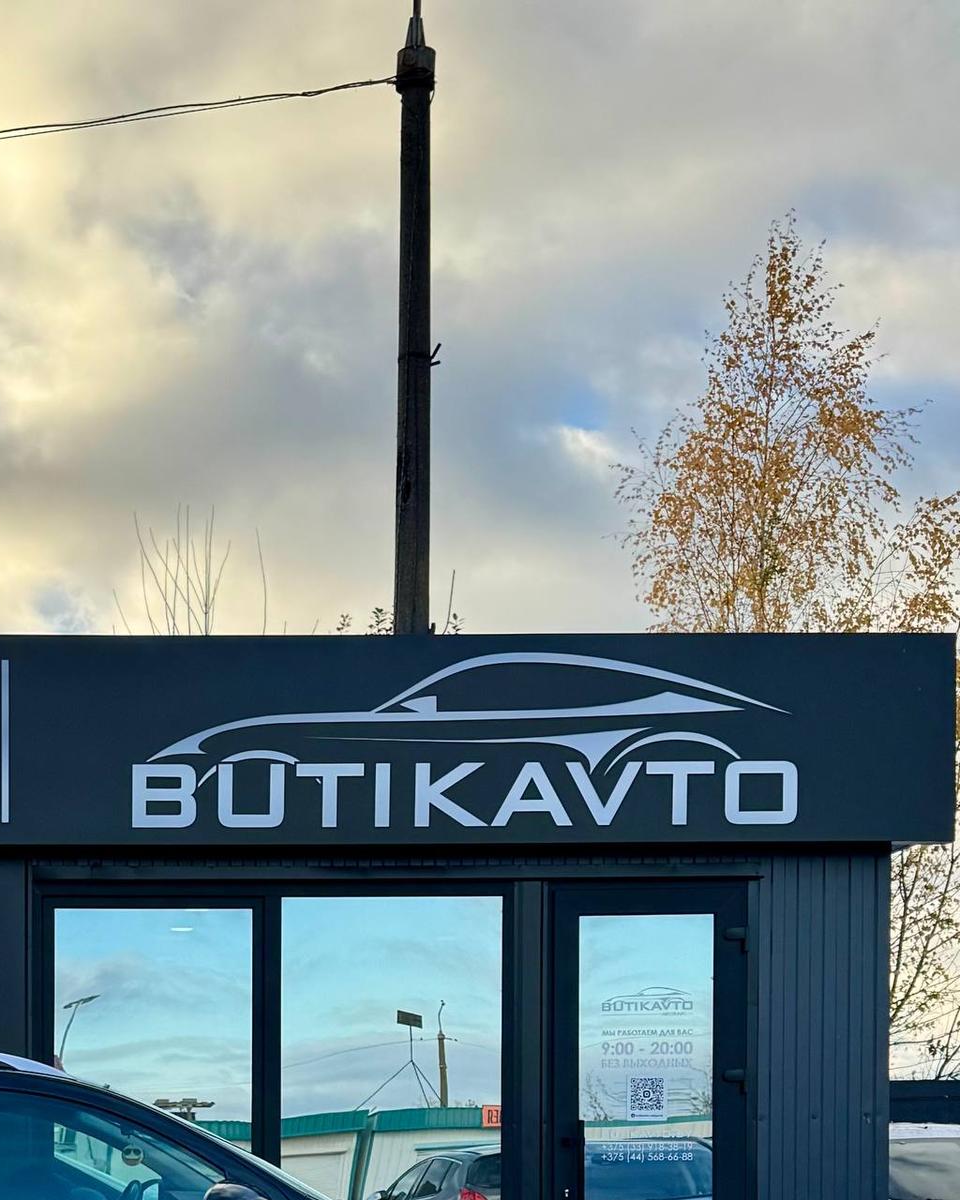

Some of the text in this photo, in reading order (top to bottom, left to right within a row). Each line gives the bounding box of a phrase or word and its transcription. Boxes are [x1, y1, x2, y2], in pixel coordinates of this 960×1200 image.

[131, 758, 798, 829] BUTIKAVTO
[601, 1000, 693, 1012] BUTIKAVTO
[601, 1042, 634, 1055] 9:00
[650, 1041, 693, 1054] 20:00
[601, 1151, 693, 1163] +375 (44) 568-66-88
